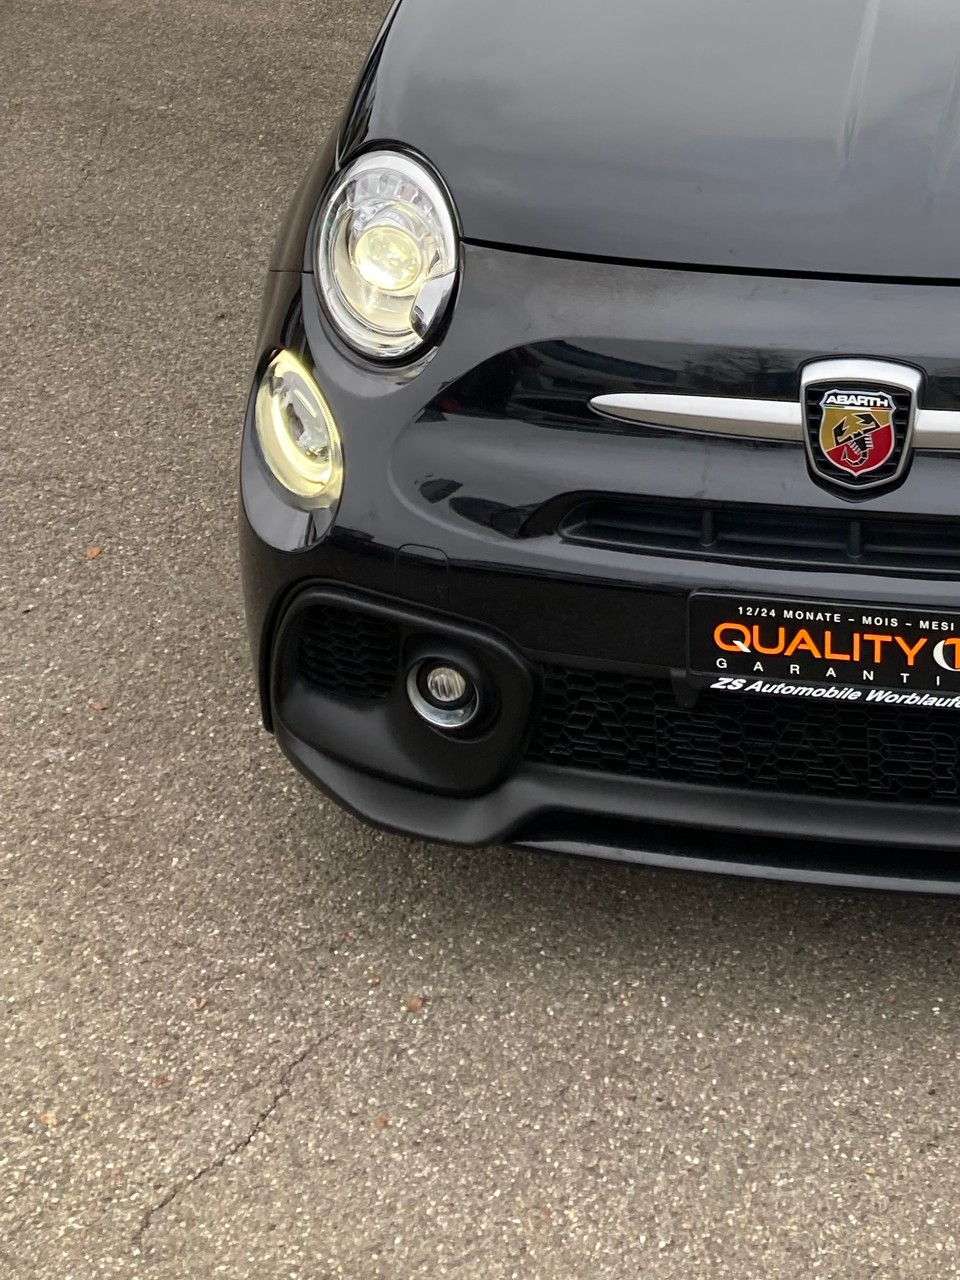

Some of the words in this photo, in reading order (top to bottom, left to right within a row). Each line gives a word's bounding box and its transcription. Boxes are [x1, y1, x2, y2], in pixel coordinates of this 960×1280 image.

[825, 394, 888, 407] ABARTH
[738, 606, 776, 618] 12/24
[783, 609, 841, 623] MONATE
[862, 616, 898, 627] MOIS
[919, 620, 955, 631] MESI
[713, 622, 928, 666] QUALITY
[710, 677, 747, 690] ZS
[744, 679, 862, 701] Automobile
